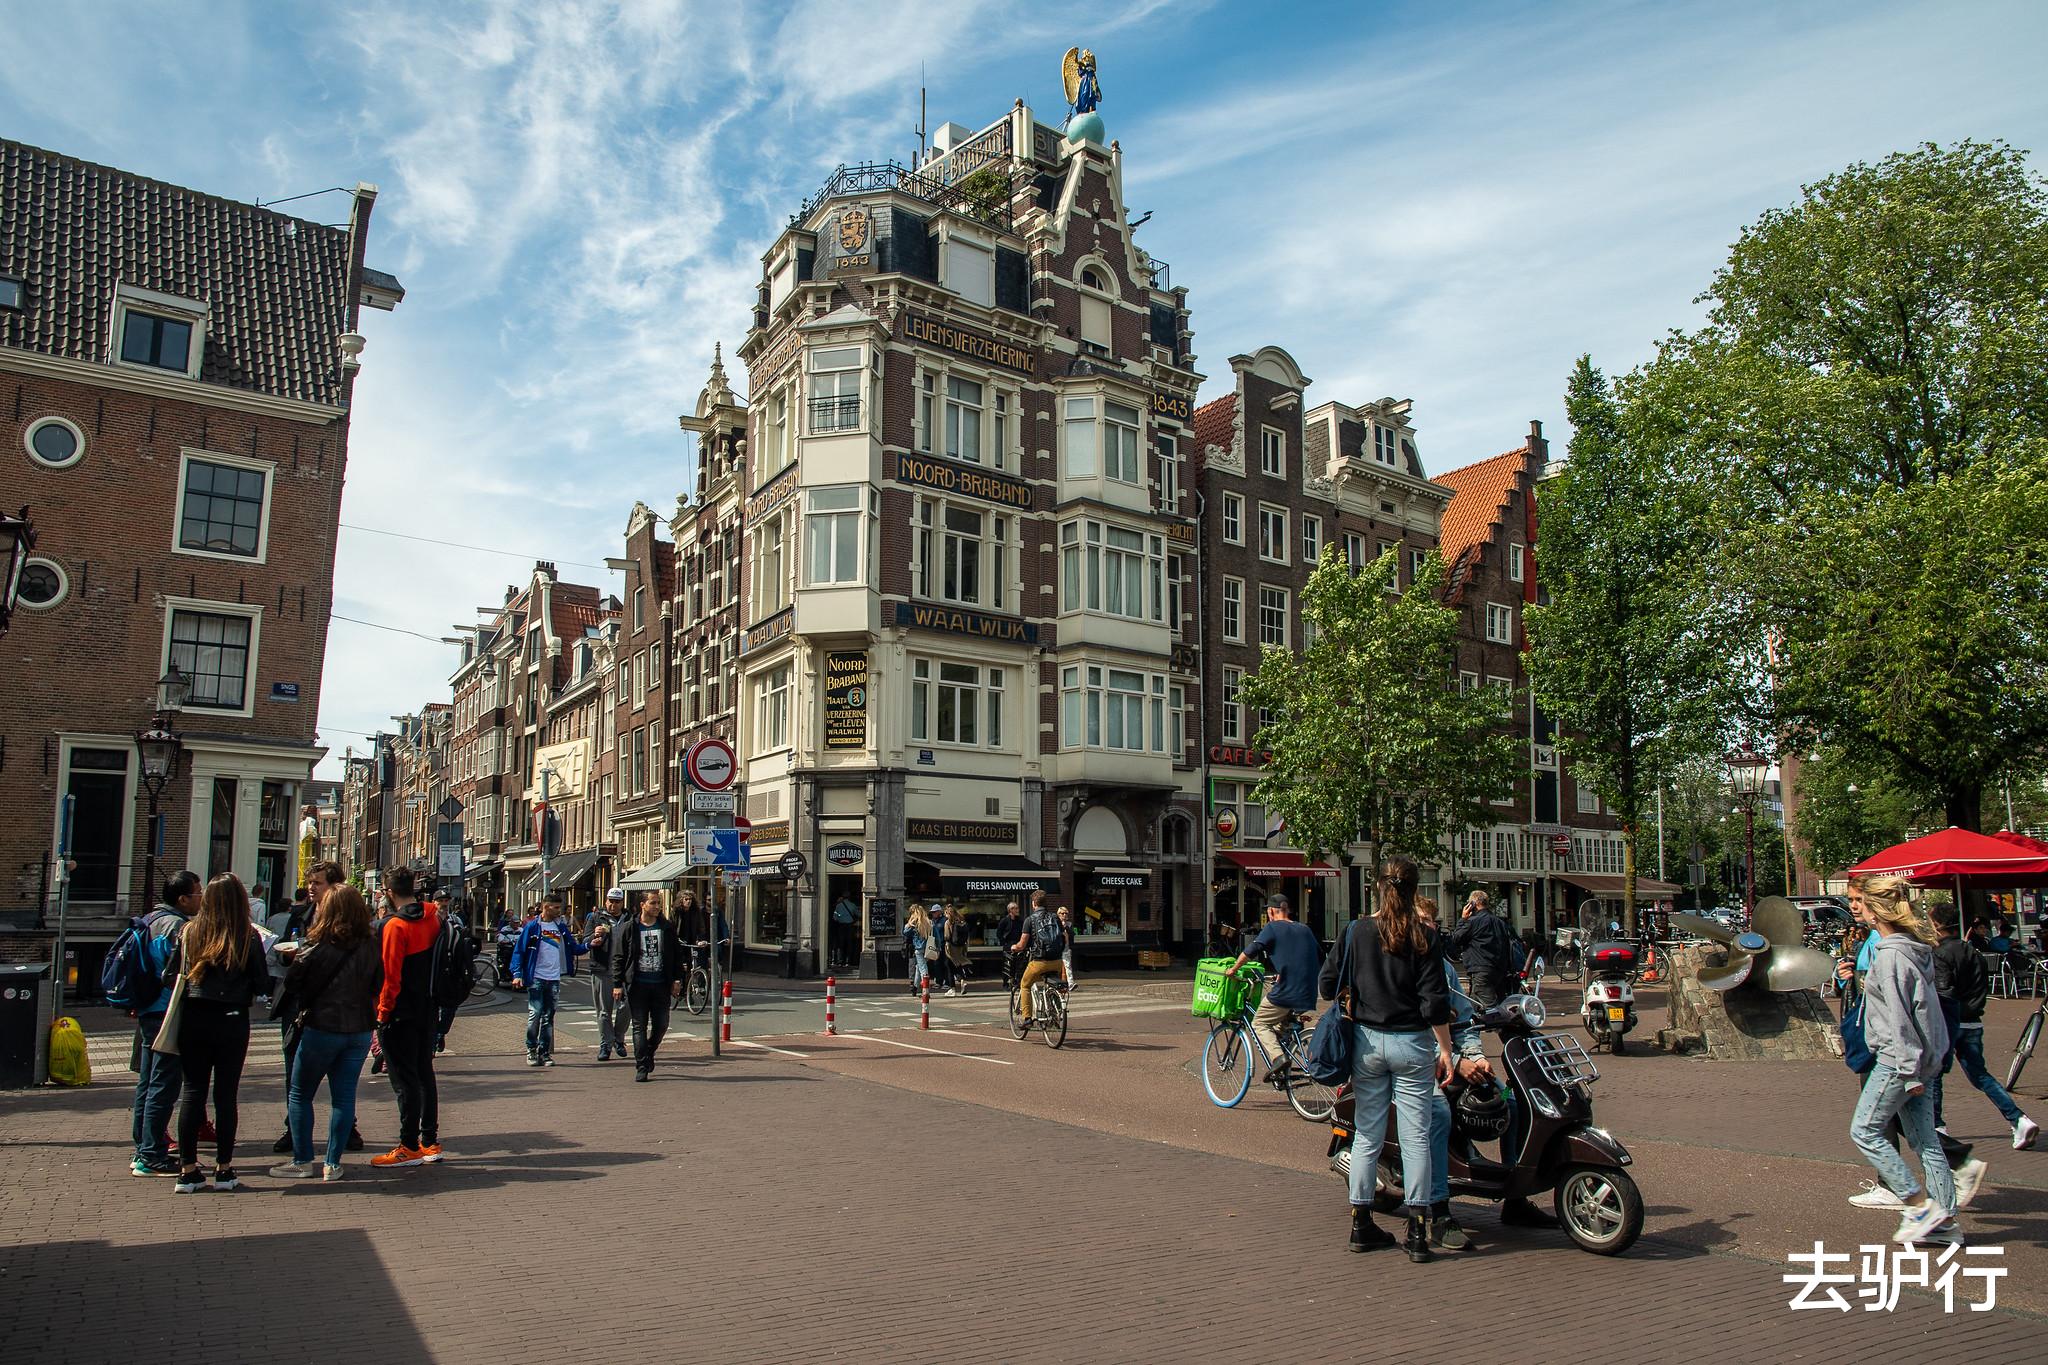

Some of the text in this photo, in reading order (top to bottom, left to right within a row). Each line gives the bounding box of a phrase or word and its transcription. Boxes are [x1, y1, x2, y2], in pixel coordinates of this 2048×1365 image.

[836, 255, 869, 268] 1843
[904, 315, 1034, 373] LEVENSVERZEKERING
[1154, 393, 1188, 418] 1843
[901, 457, 1031, 506] NOORD-BRABAND
[1167, 523, 1194, 540] ERICHT
[914, 607, 1026, 640] WAALWIJK
[828, 657, 867, 671] NOORD-
[827, 672, 867, 690] BRABAND
[826, 710, 866, 719] VERZEKERING
[843, 718, 865, 728] LEVEN
[911, 823, 1015, 839] KAAS EN BROODJES
[830, 849, 862, 859] WALS KAAS
[1894, 869, 1915, 877] BIER
[966, 881, 1040, 890] FRESH SANDWICHES
[1101, 876, 1143, 886] CHEESE CAKE
[1200, 974, 1220, 989] Uber
[1197, 987, 1218, 1003] Eats
